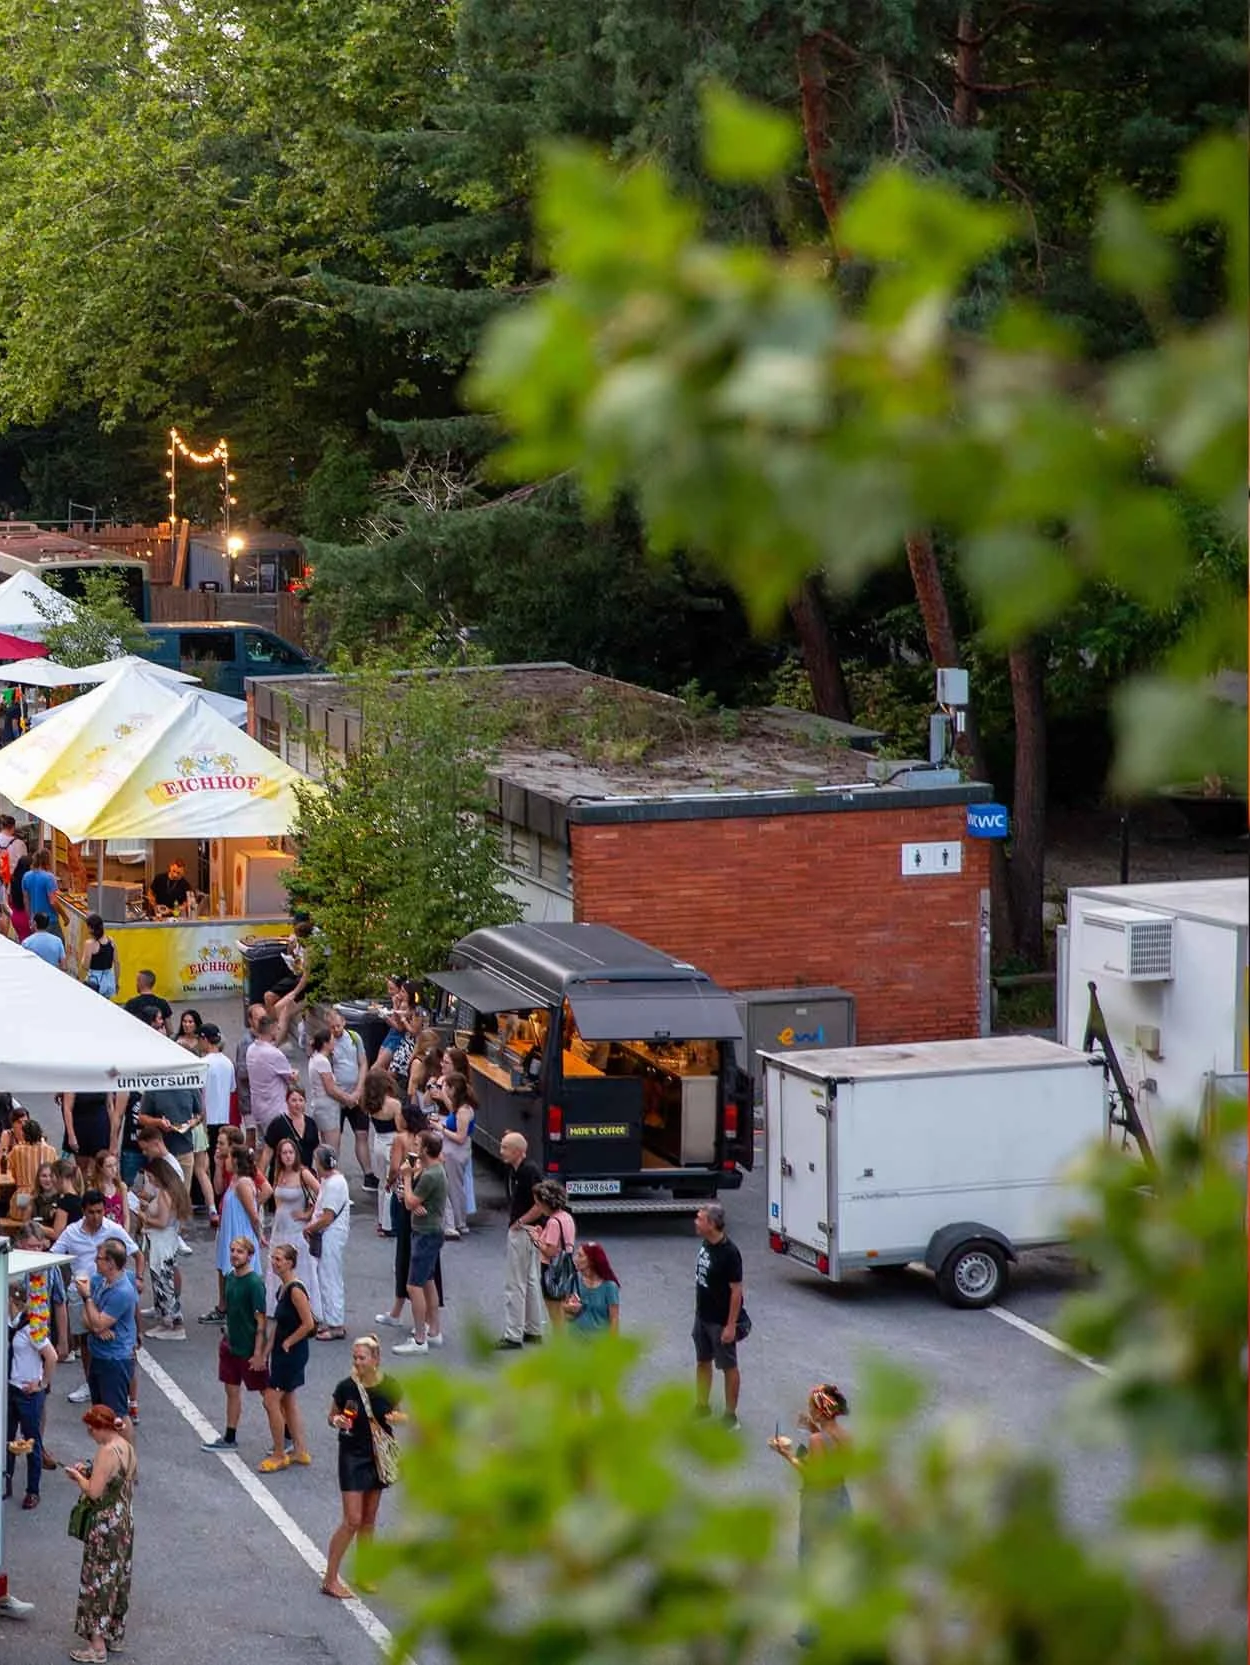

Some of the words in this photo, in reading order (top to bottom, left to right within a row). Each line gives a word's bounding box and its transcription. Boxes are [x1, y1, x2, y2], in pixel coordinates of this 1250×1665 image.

[162, 775, 261, 796] EICHHOF
[978, 814, 1005, 829] WC
[189, 961, 239, 975] EICHHOF
[117, 1074, 204, 1089] universum.
